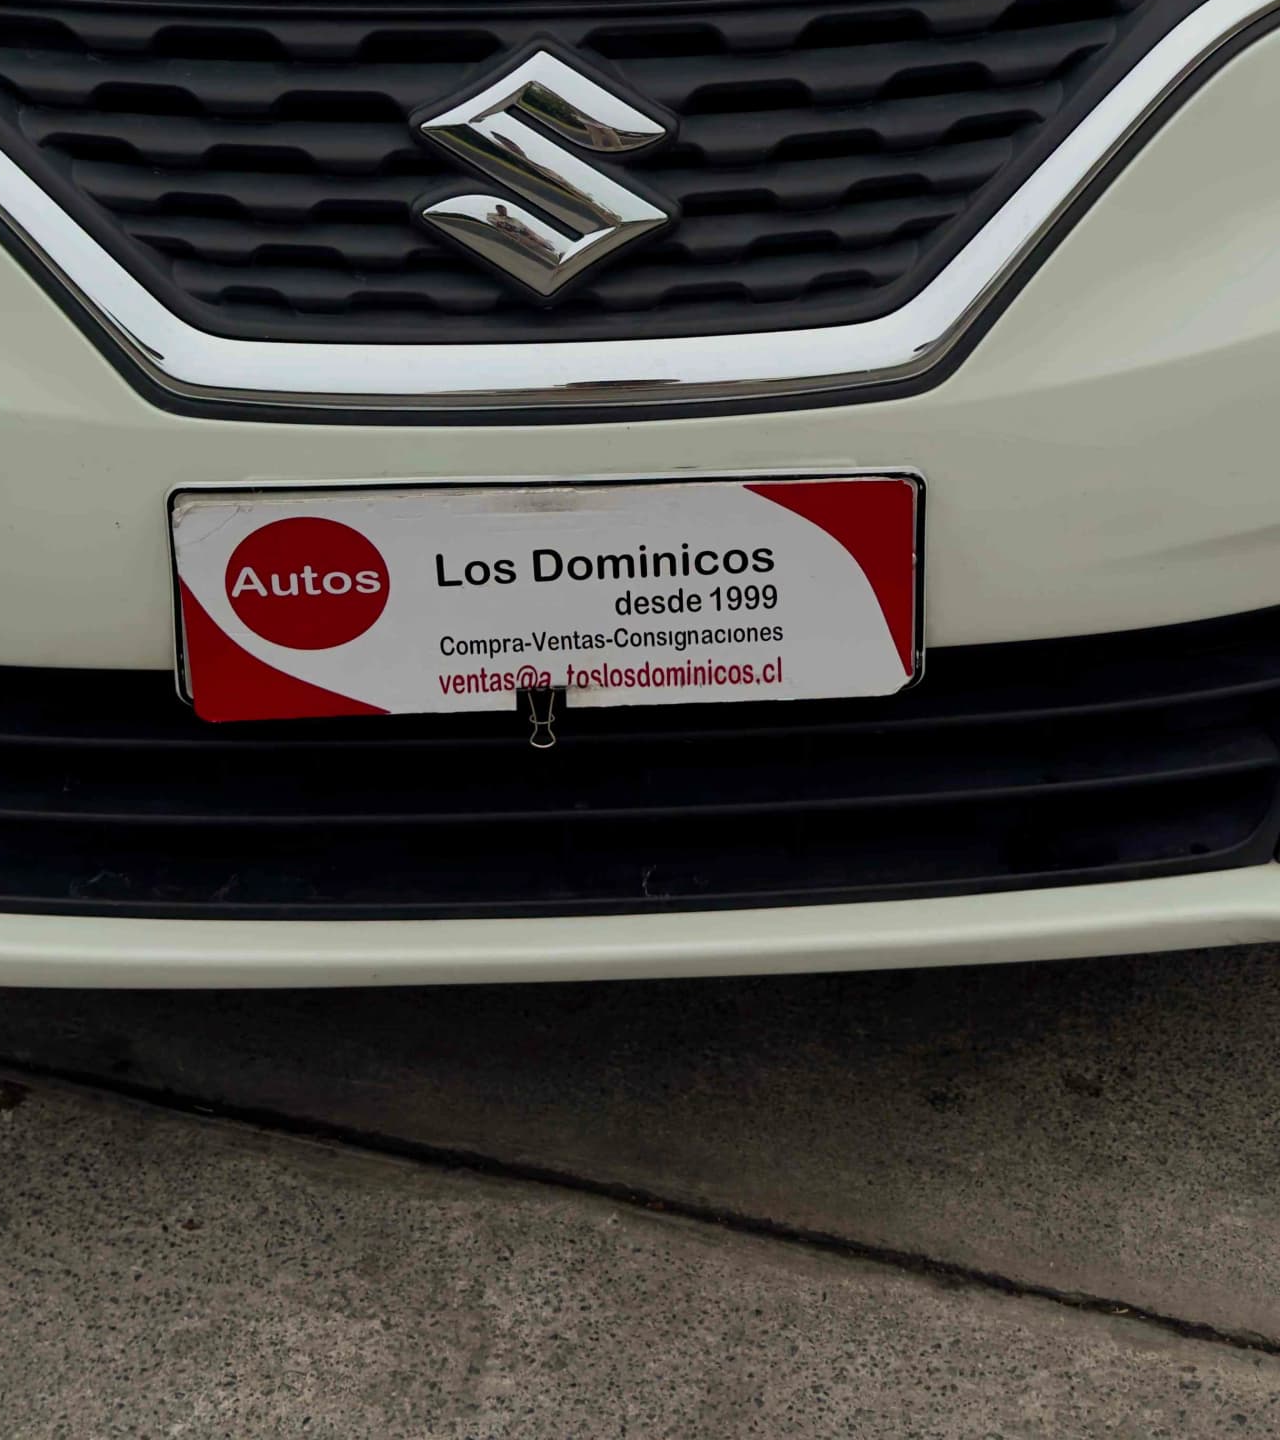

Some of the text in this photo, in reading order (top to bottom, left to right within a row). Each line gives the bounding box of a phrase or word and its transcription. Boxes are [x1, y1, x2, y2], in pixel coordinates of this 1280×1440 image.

[231, 563, 382, 598] Autos
[435, 542, 776, 587] Los Dominicos
[614, 584, 779, 616] desde 1999
[439, 625, 785, 659] Compra-Ventas-Consignaciones
[438, 656, 784, 695] ventas@atoslosdominicos.cl
